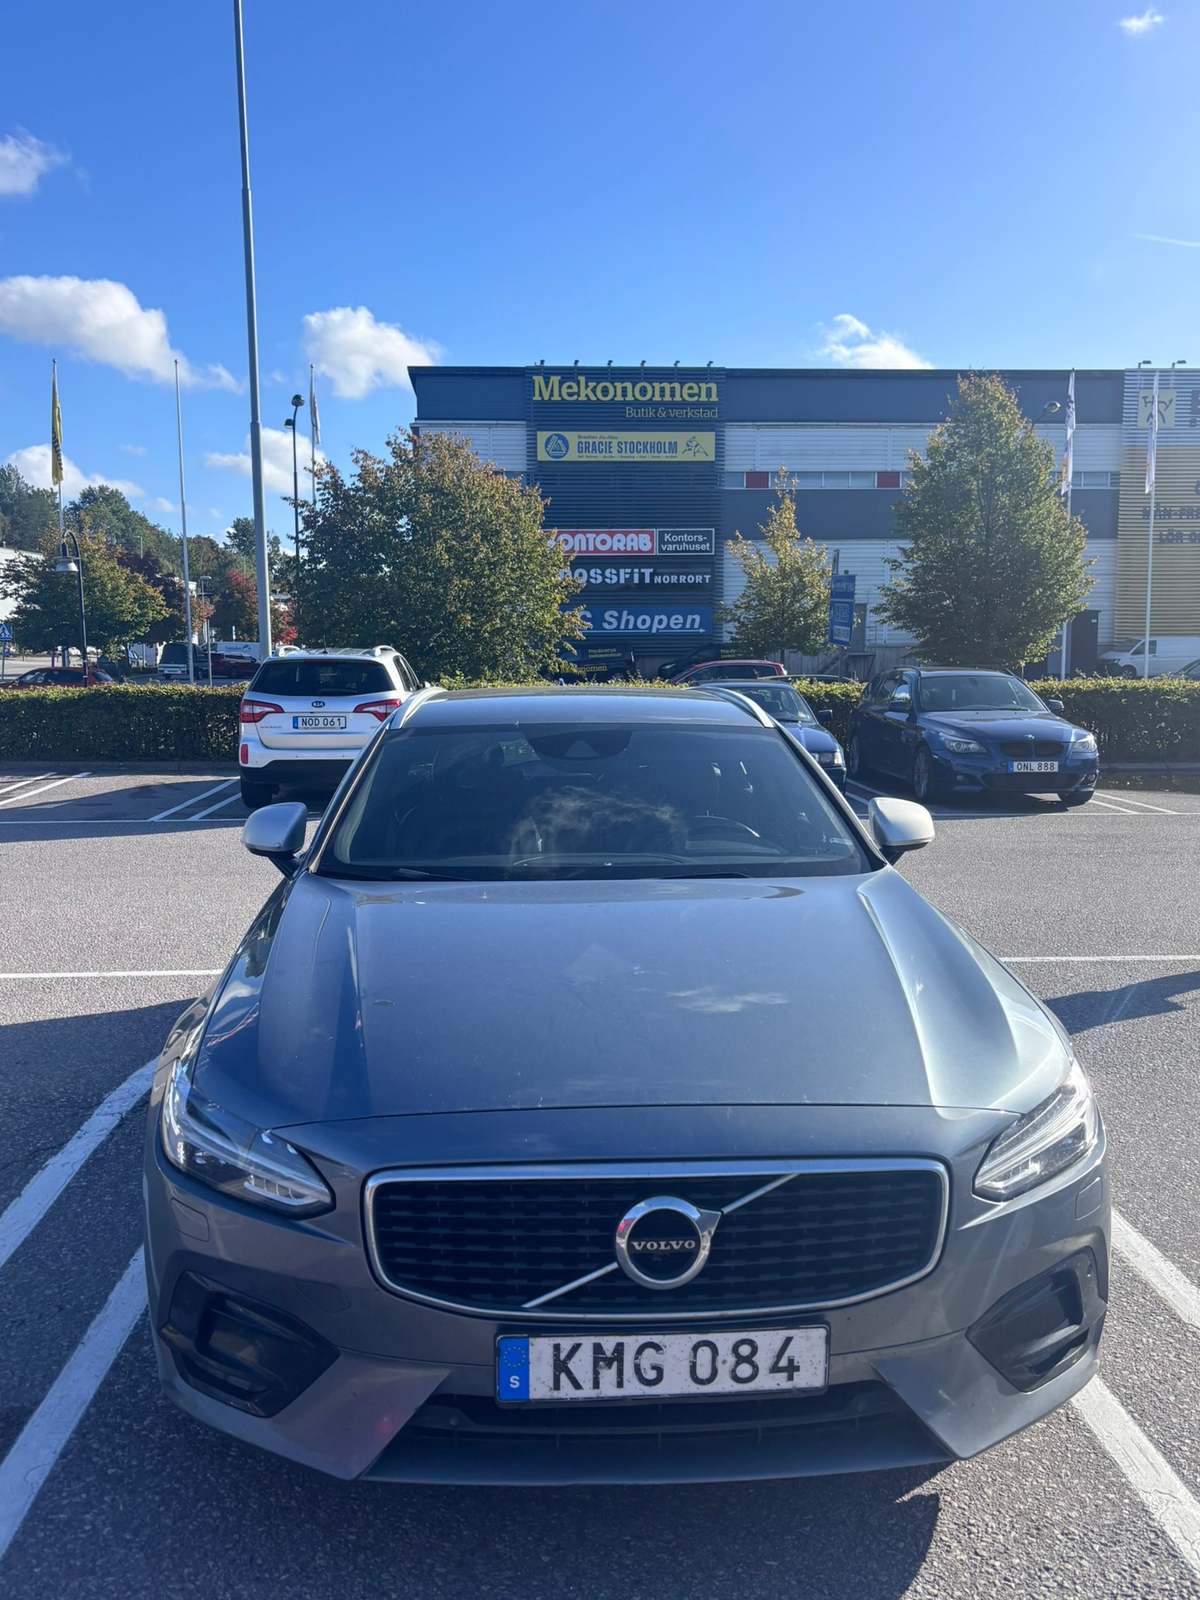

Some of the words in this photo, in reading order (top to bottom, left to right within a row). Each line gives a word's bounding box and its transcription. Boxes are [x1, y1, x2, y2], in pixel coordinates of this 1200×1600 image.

[533, 376, 718, 401] Mekonomen
[625, 407, 657, 418] Butik
[658, 407, 666, 418] &
[668, 407, 718, 418] verkstad
[577, 441, 613, 454] GRACIE
[617, 441, 678, 454] STOCKHOLM
[548, 533, 652, 551] ONTORAB
[664, 533, 707, 542] Kontors-
[661, 543, 710, 551] varuhuset
[654, 575, 711, 583] NORRORT
[602, 610, 701, 633] Shopen
[302, 718, 320, 726] NOD
[323, 718, 340, 726] 061
[1017, 762, 1034, 771] ONL
[1037, 762, 1054, 771] 888
[631, 1239, 696, 1251] VOLVO
[552, 1341, 665, 1391] KMG
[689, 1336, 800, 1385] 084
[509, 1376, 520, 1388] S
